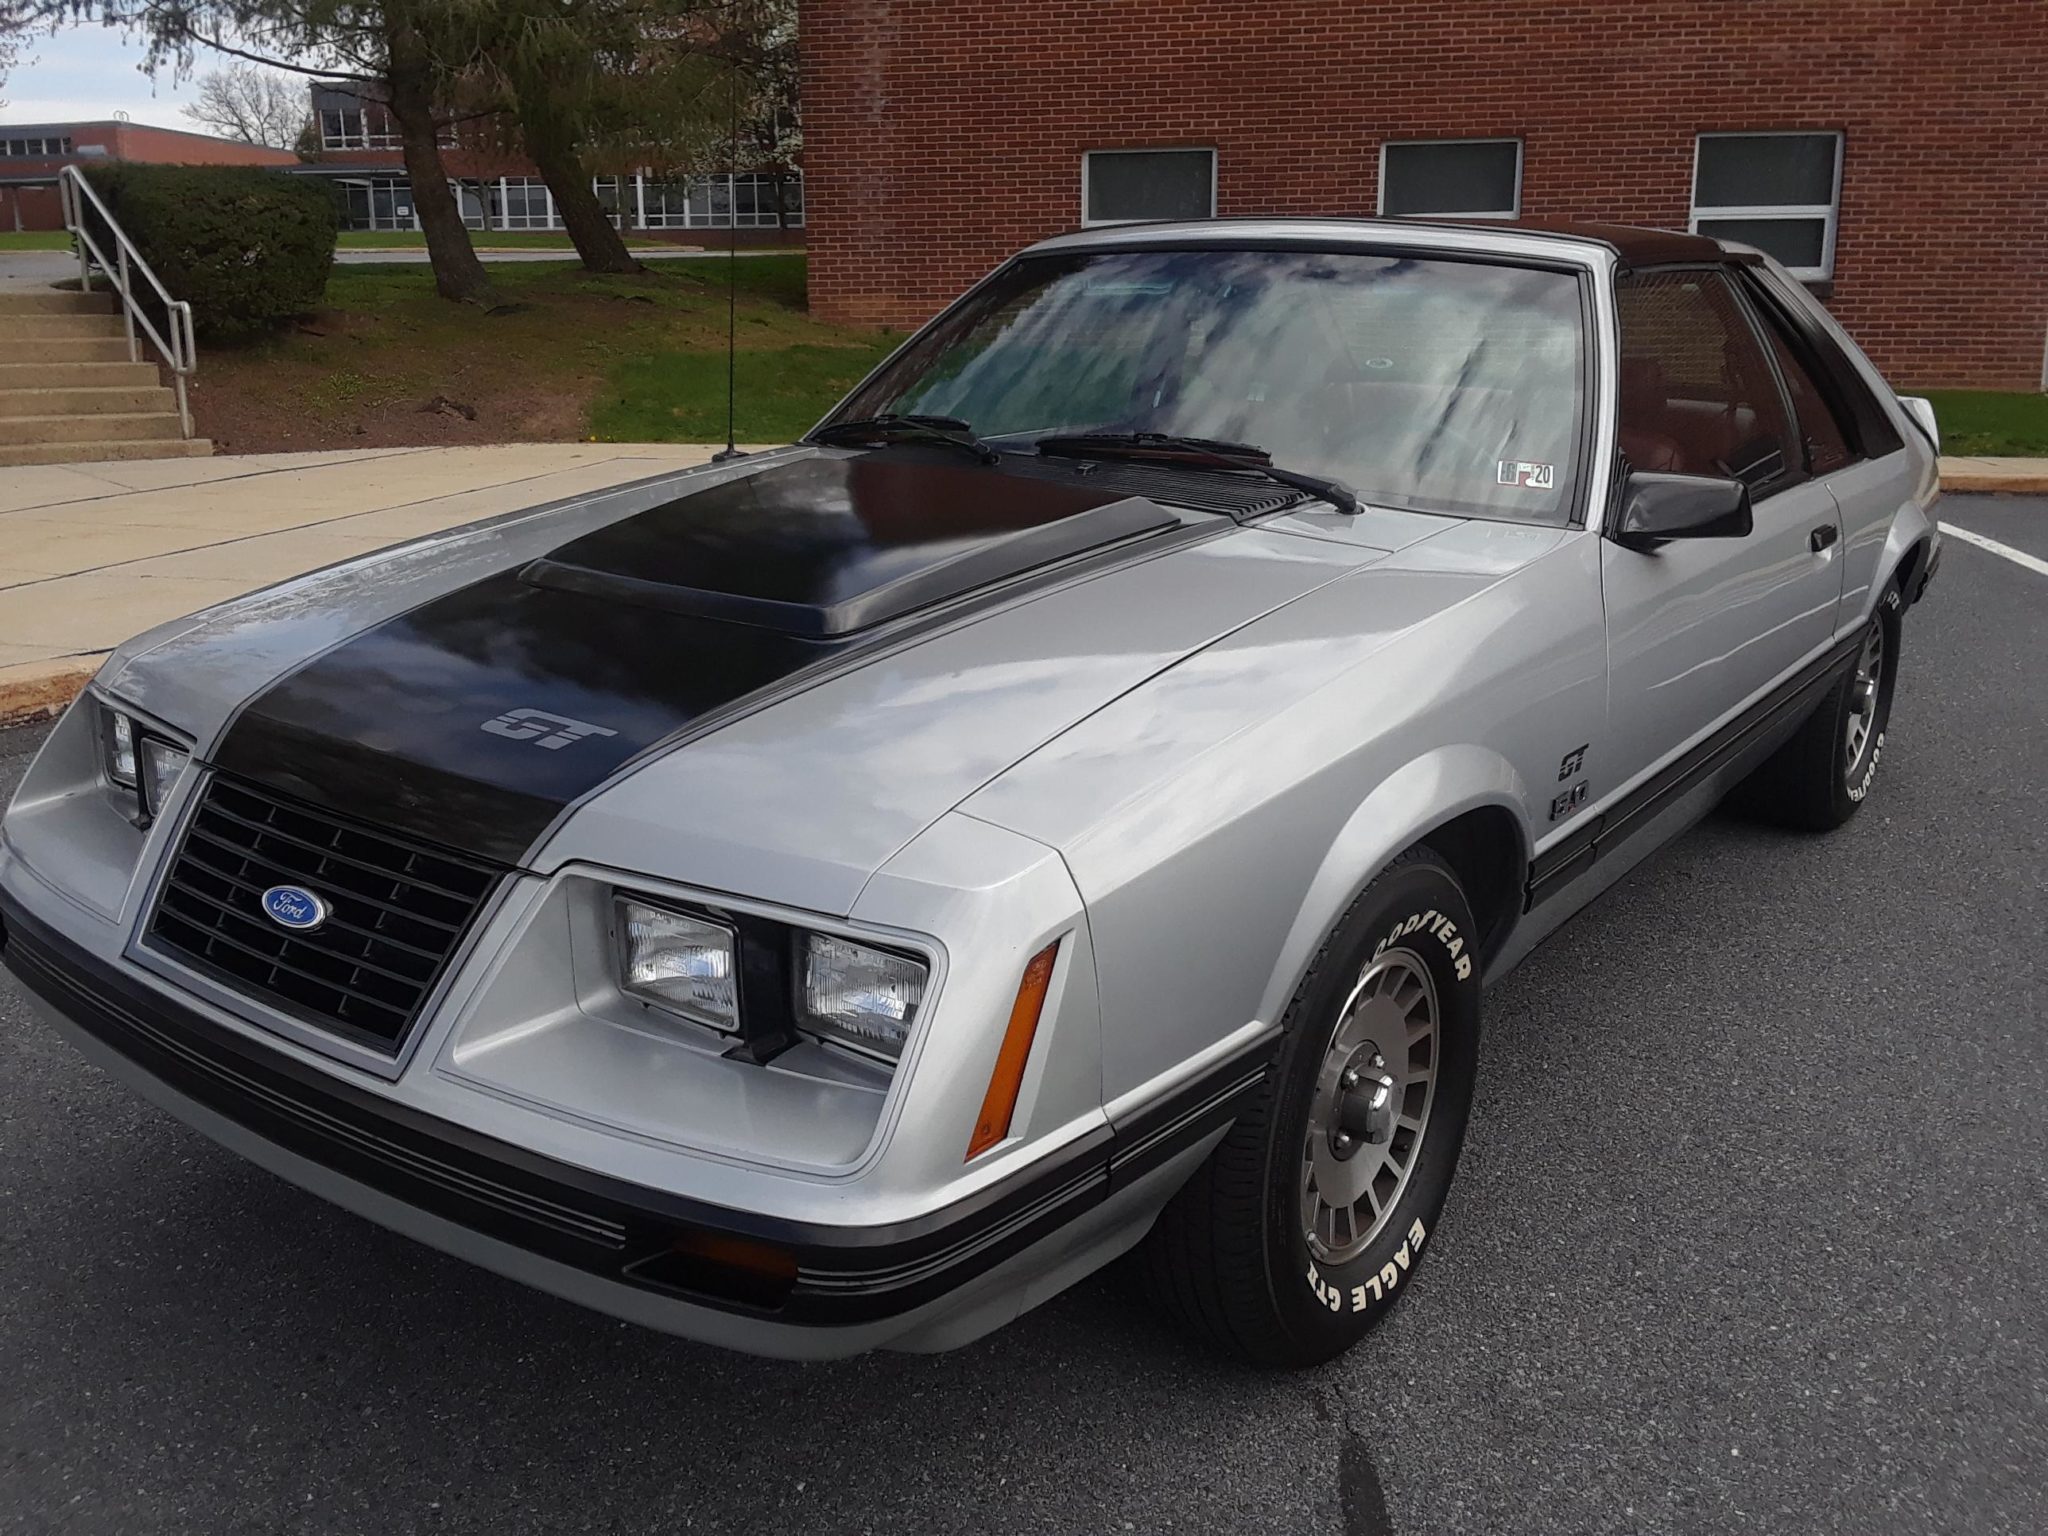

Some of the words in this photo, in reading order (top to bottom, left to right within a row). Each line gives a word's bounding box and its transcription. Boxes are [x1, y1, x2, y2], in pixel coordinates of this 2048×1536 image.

[1535, 465, 1551, 484] 20
[480, 708, 619, 750] GT
[1558, 743, 1590, 782] GT
[272, 891, 308, 919] Ford
[1351, 1217, 1426, 1312] EAGLE
